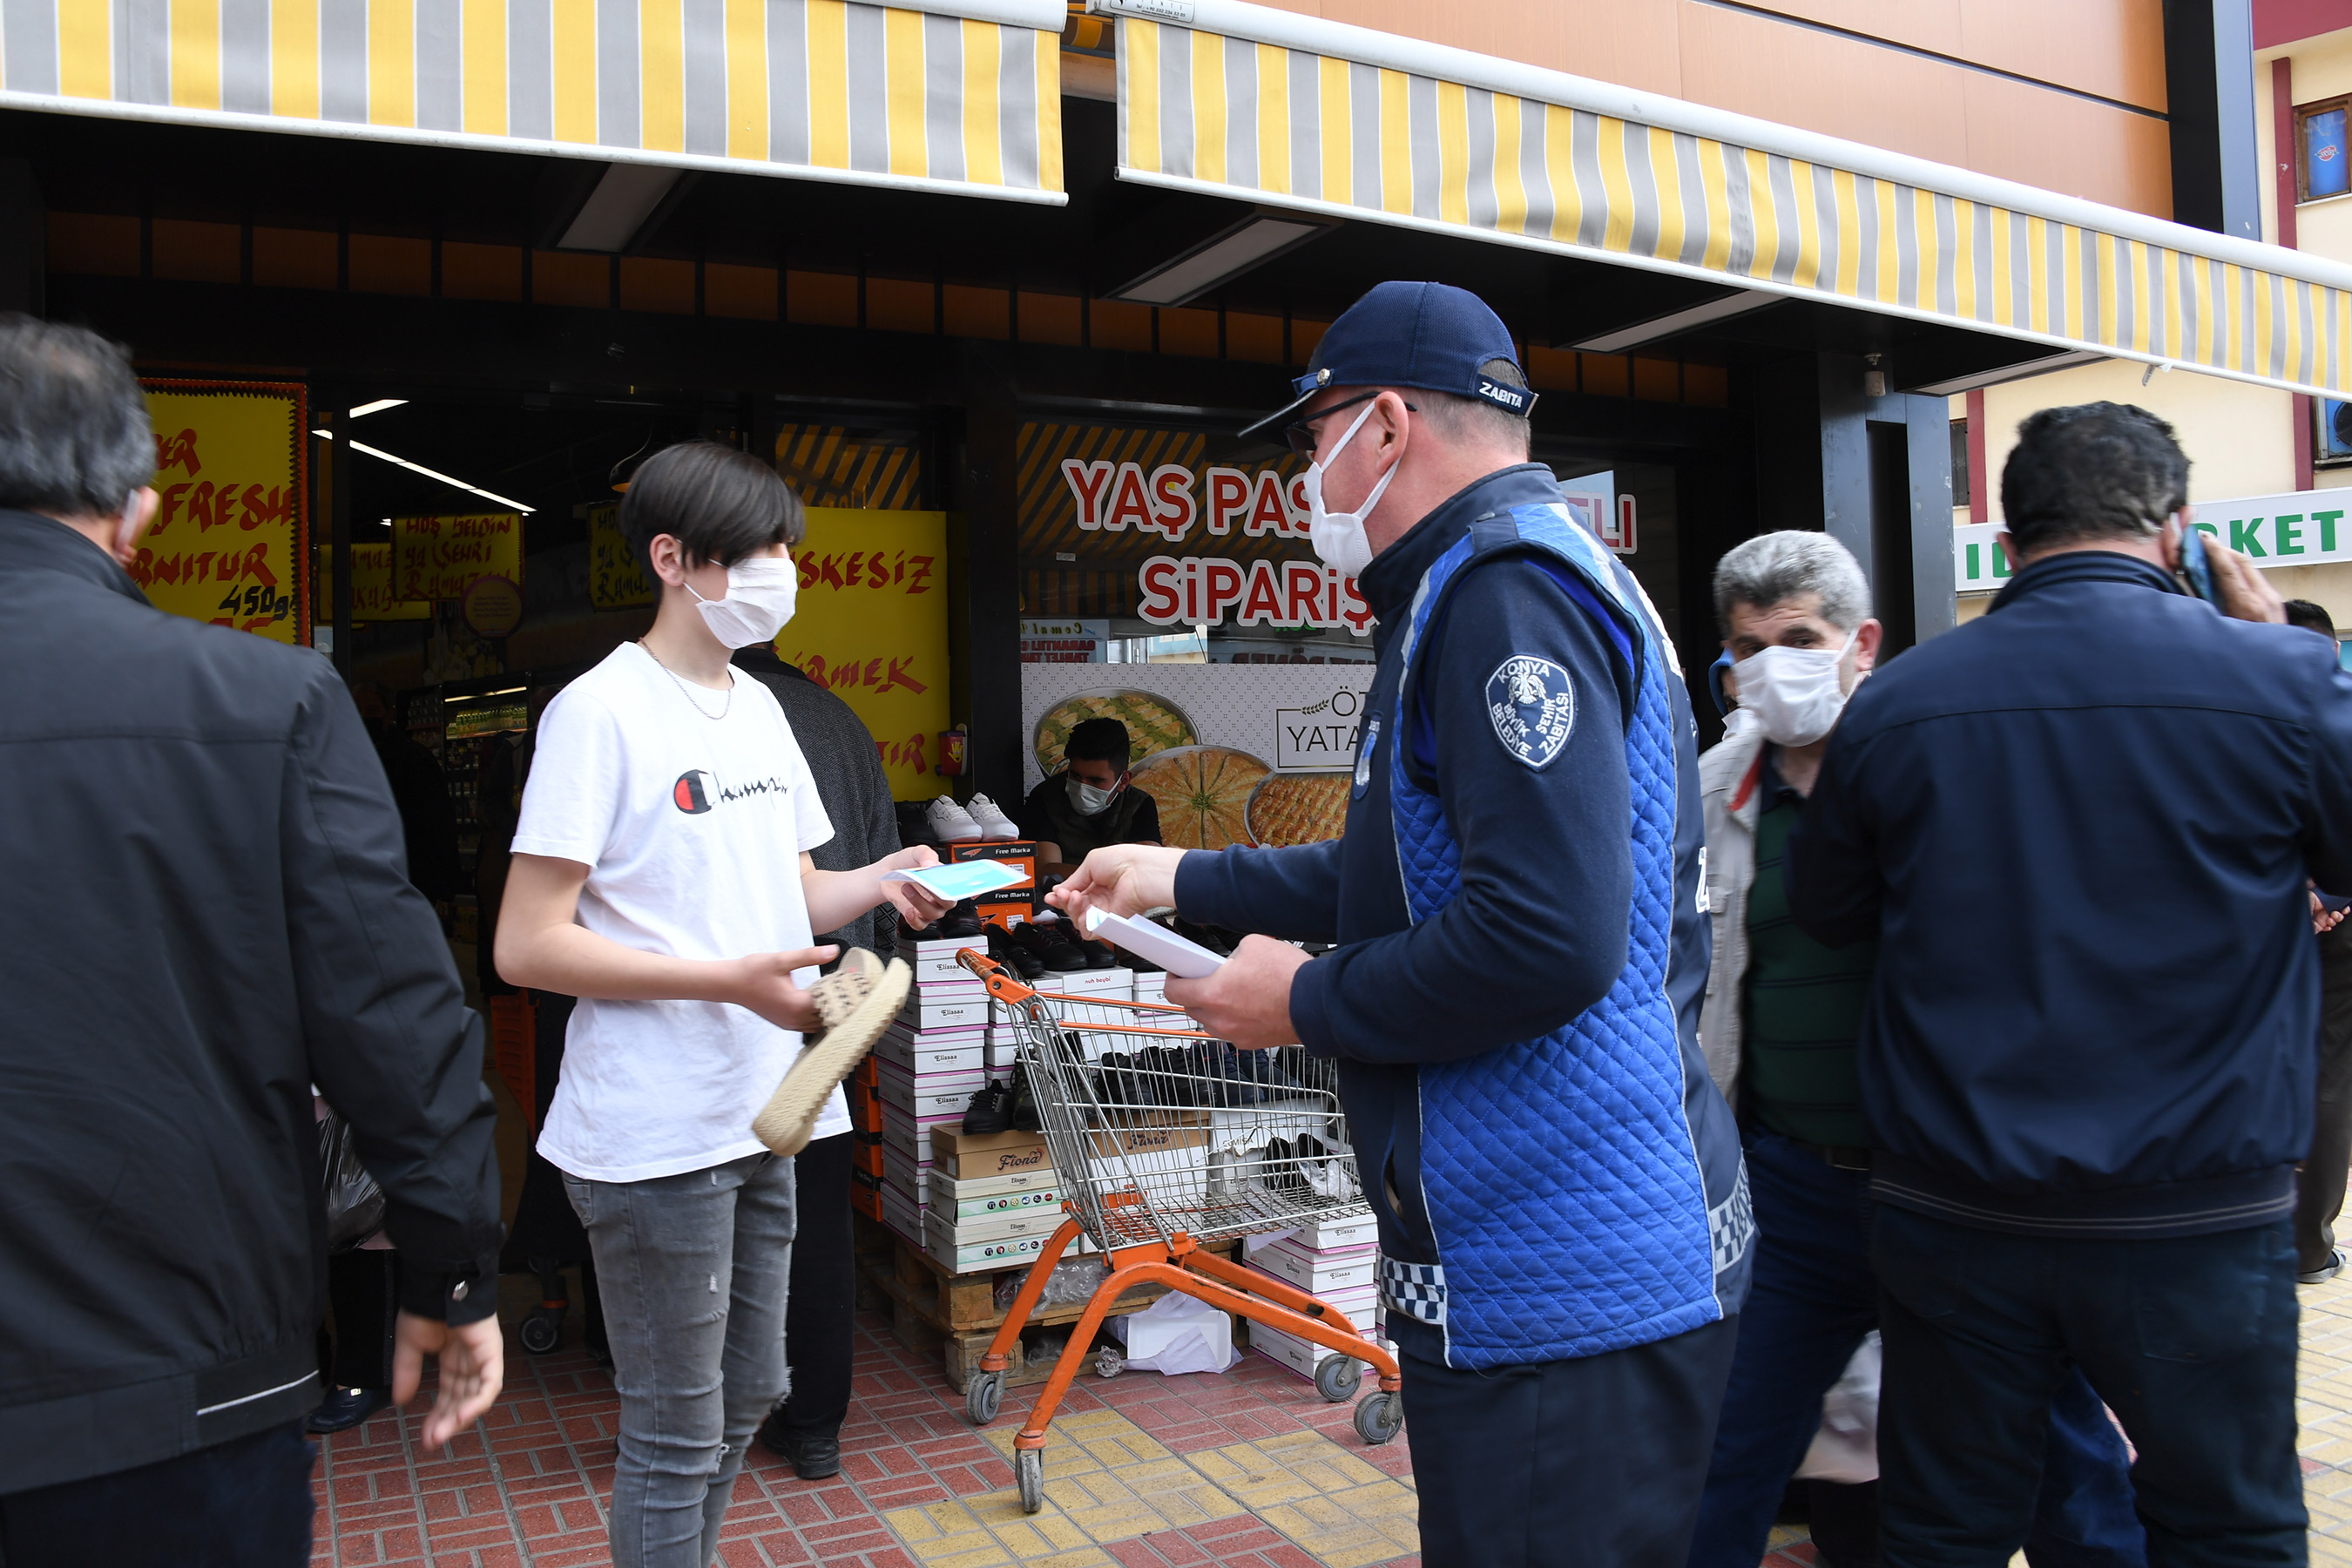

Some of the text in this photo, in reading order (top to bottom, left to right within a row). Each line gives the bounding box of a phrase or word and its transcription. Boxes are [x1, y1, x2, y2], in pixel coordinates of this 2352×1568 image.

[1479, 382, 1523, 409] ZABITA
[1066, 464, 1193, 537] YAŞ
[2189, 510, 2344, 558] KET
[1497, 660, 1550, 685] KONYA
[997, 1150, 1044, 1171] Fiona
